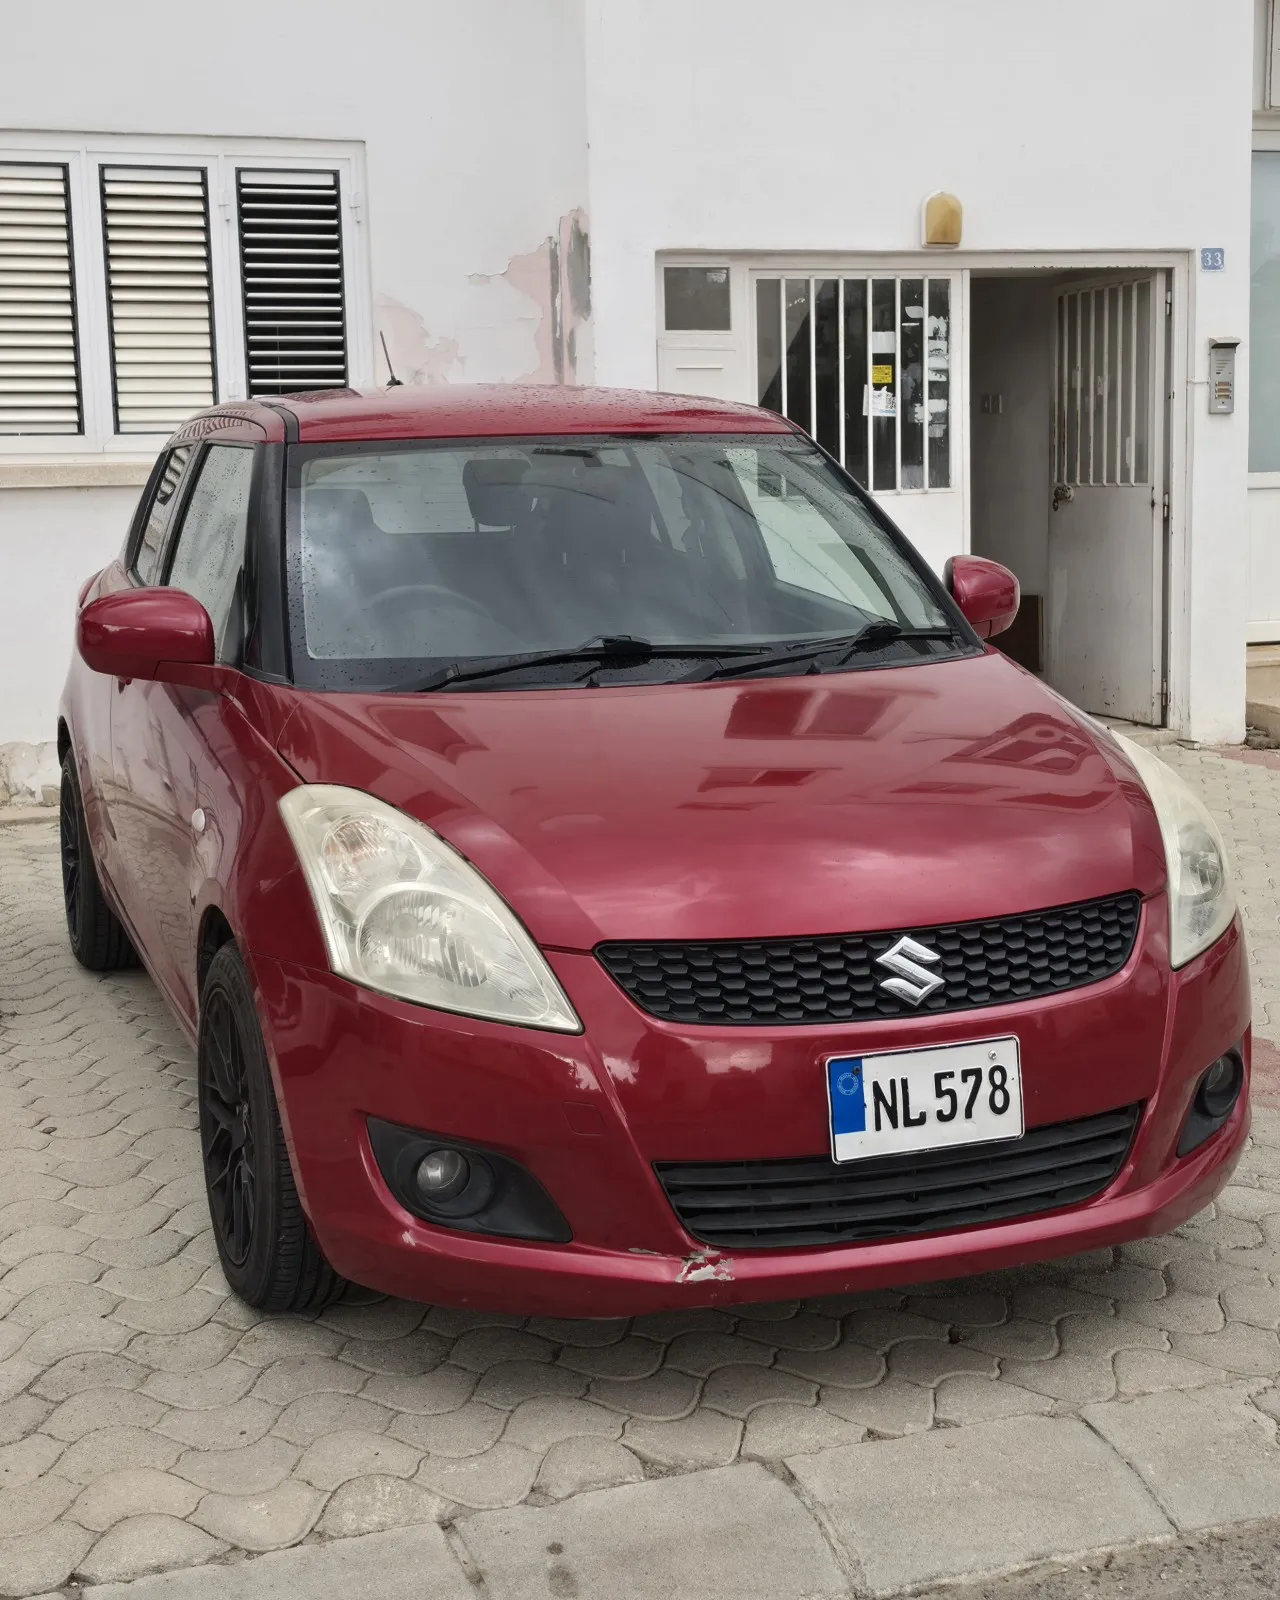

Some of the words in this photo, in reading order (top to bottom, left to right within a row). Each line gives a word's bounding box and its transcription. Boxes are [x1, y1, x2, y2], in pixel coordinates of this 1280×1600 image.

[1204, 252, 1221, 266] 33
[872, 1076, 926, 1132] NL
[934, 1065, 1010, 1123] 578
